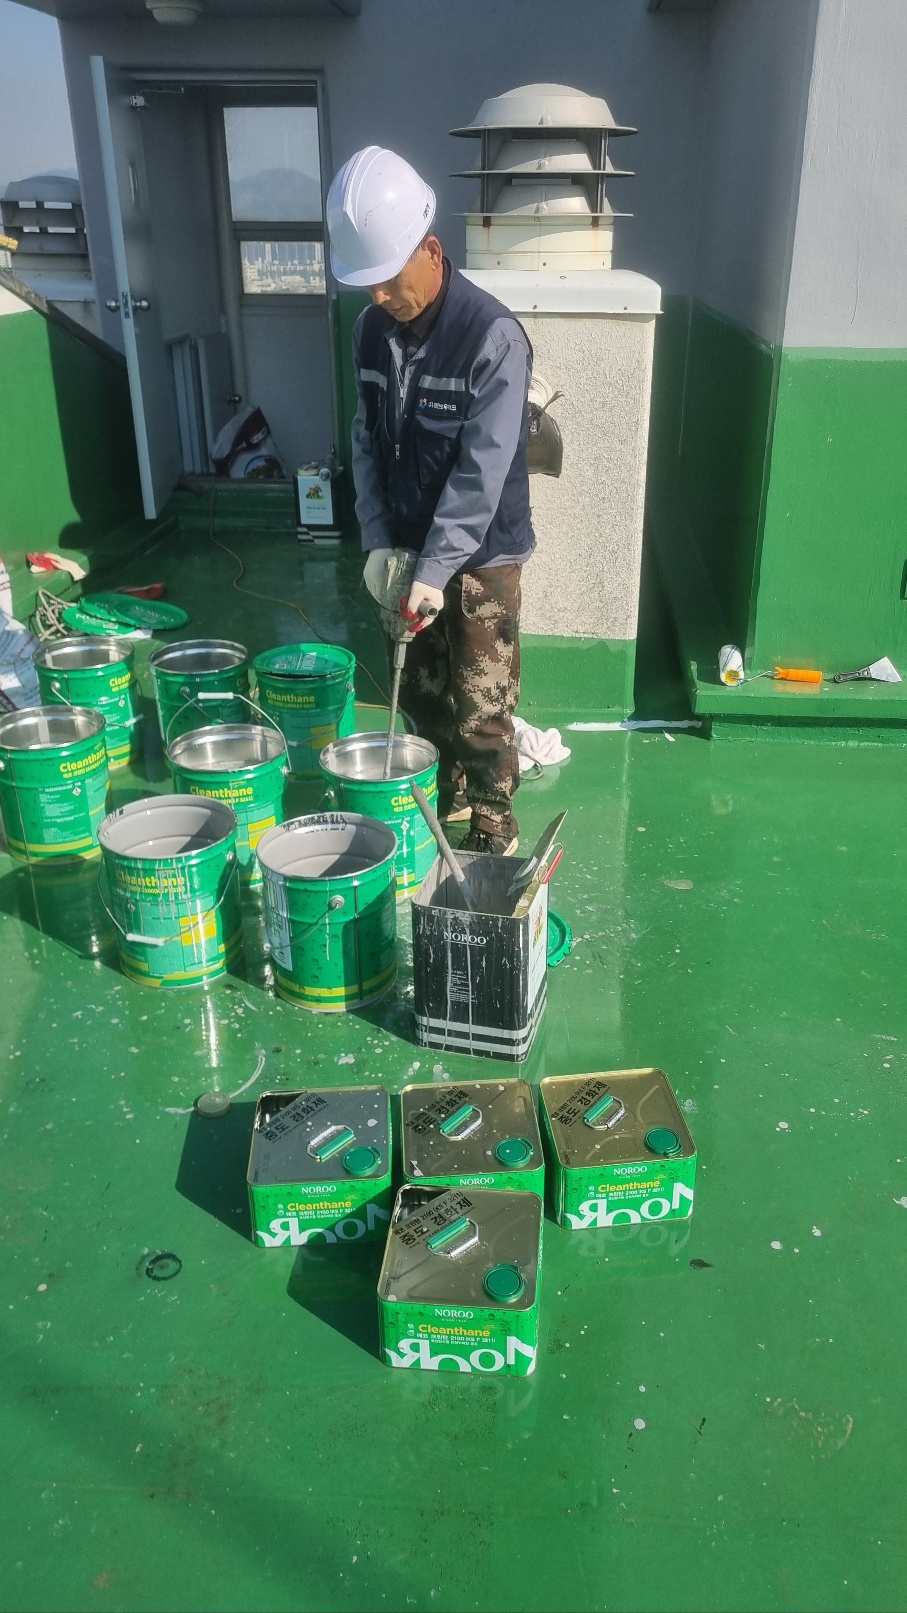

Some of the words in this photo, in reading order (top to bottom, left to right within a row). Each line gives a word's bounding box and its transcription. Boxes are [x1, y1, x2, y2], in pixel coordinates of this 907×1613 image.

[266, 690, 315, 703] Cleanthane
[190, 786, 253, 798] Cleanthane
[444, 931, 486, 945] NOROO
[557, 1104, 581, 1128] 중도
[577, 1078, 608, 1109] 경화제
[411, 1112, 437, 1137] 중도
[434, 1087, 469, 1119] 경화제
[262, 1119, 291, 1144] 중도
[289, 1093, 327, 1125] 경화제
[614, 1166, 647, 1175] NOROO
[460, 1177, 494, 1186] NOROO
[598, 1181, 660, 1193] Cleanthane
[302, 1185, 336, 1194] NOROO
[288, 1201, 352, 1211] Cleanthane
[398, 1221, 430, 1248] 중도
[430, 1195, 473, 1229] 경화제
[435, 1309, 474, 1319] NOROO
[418, 1323, 490, 1337] Cleanthane
